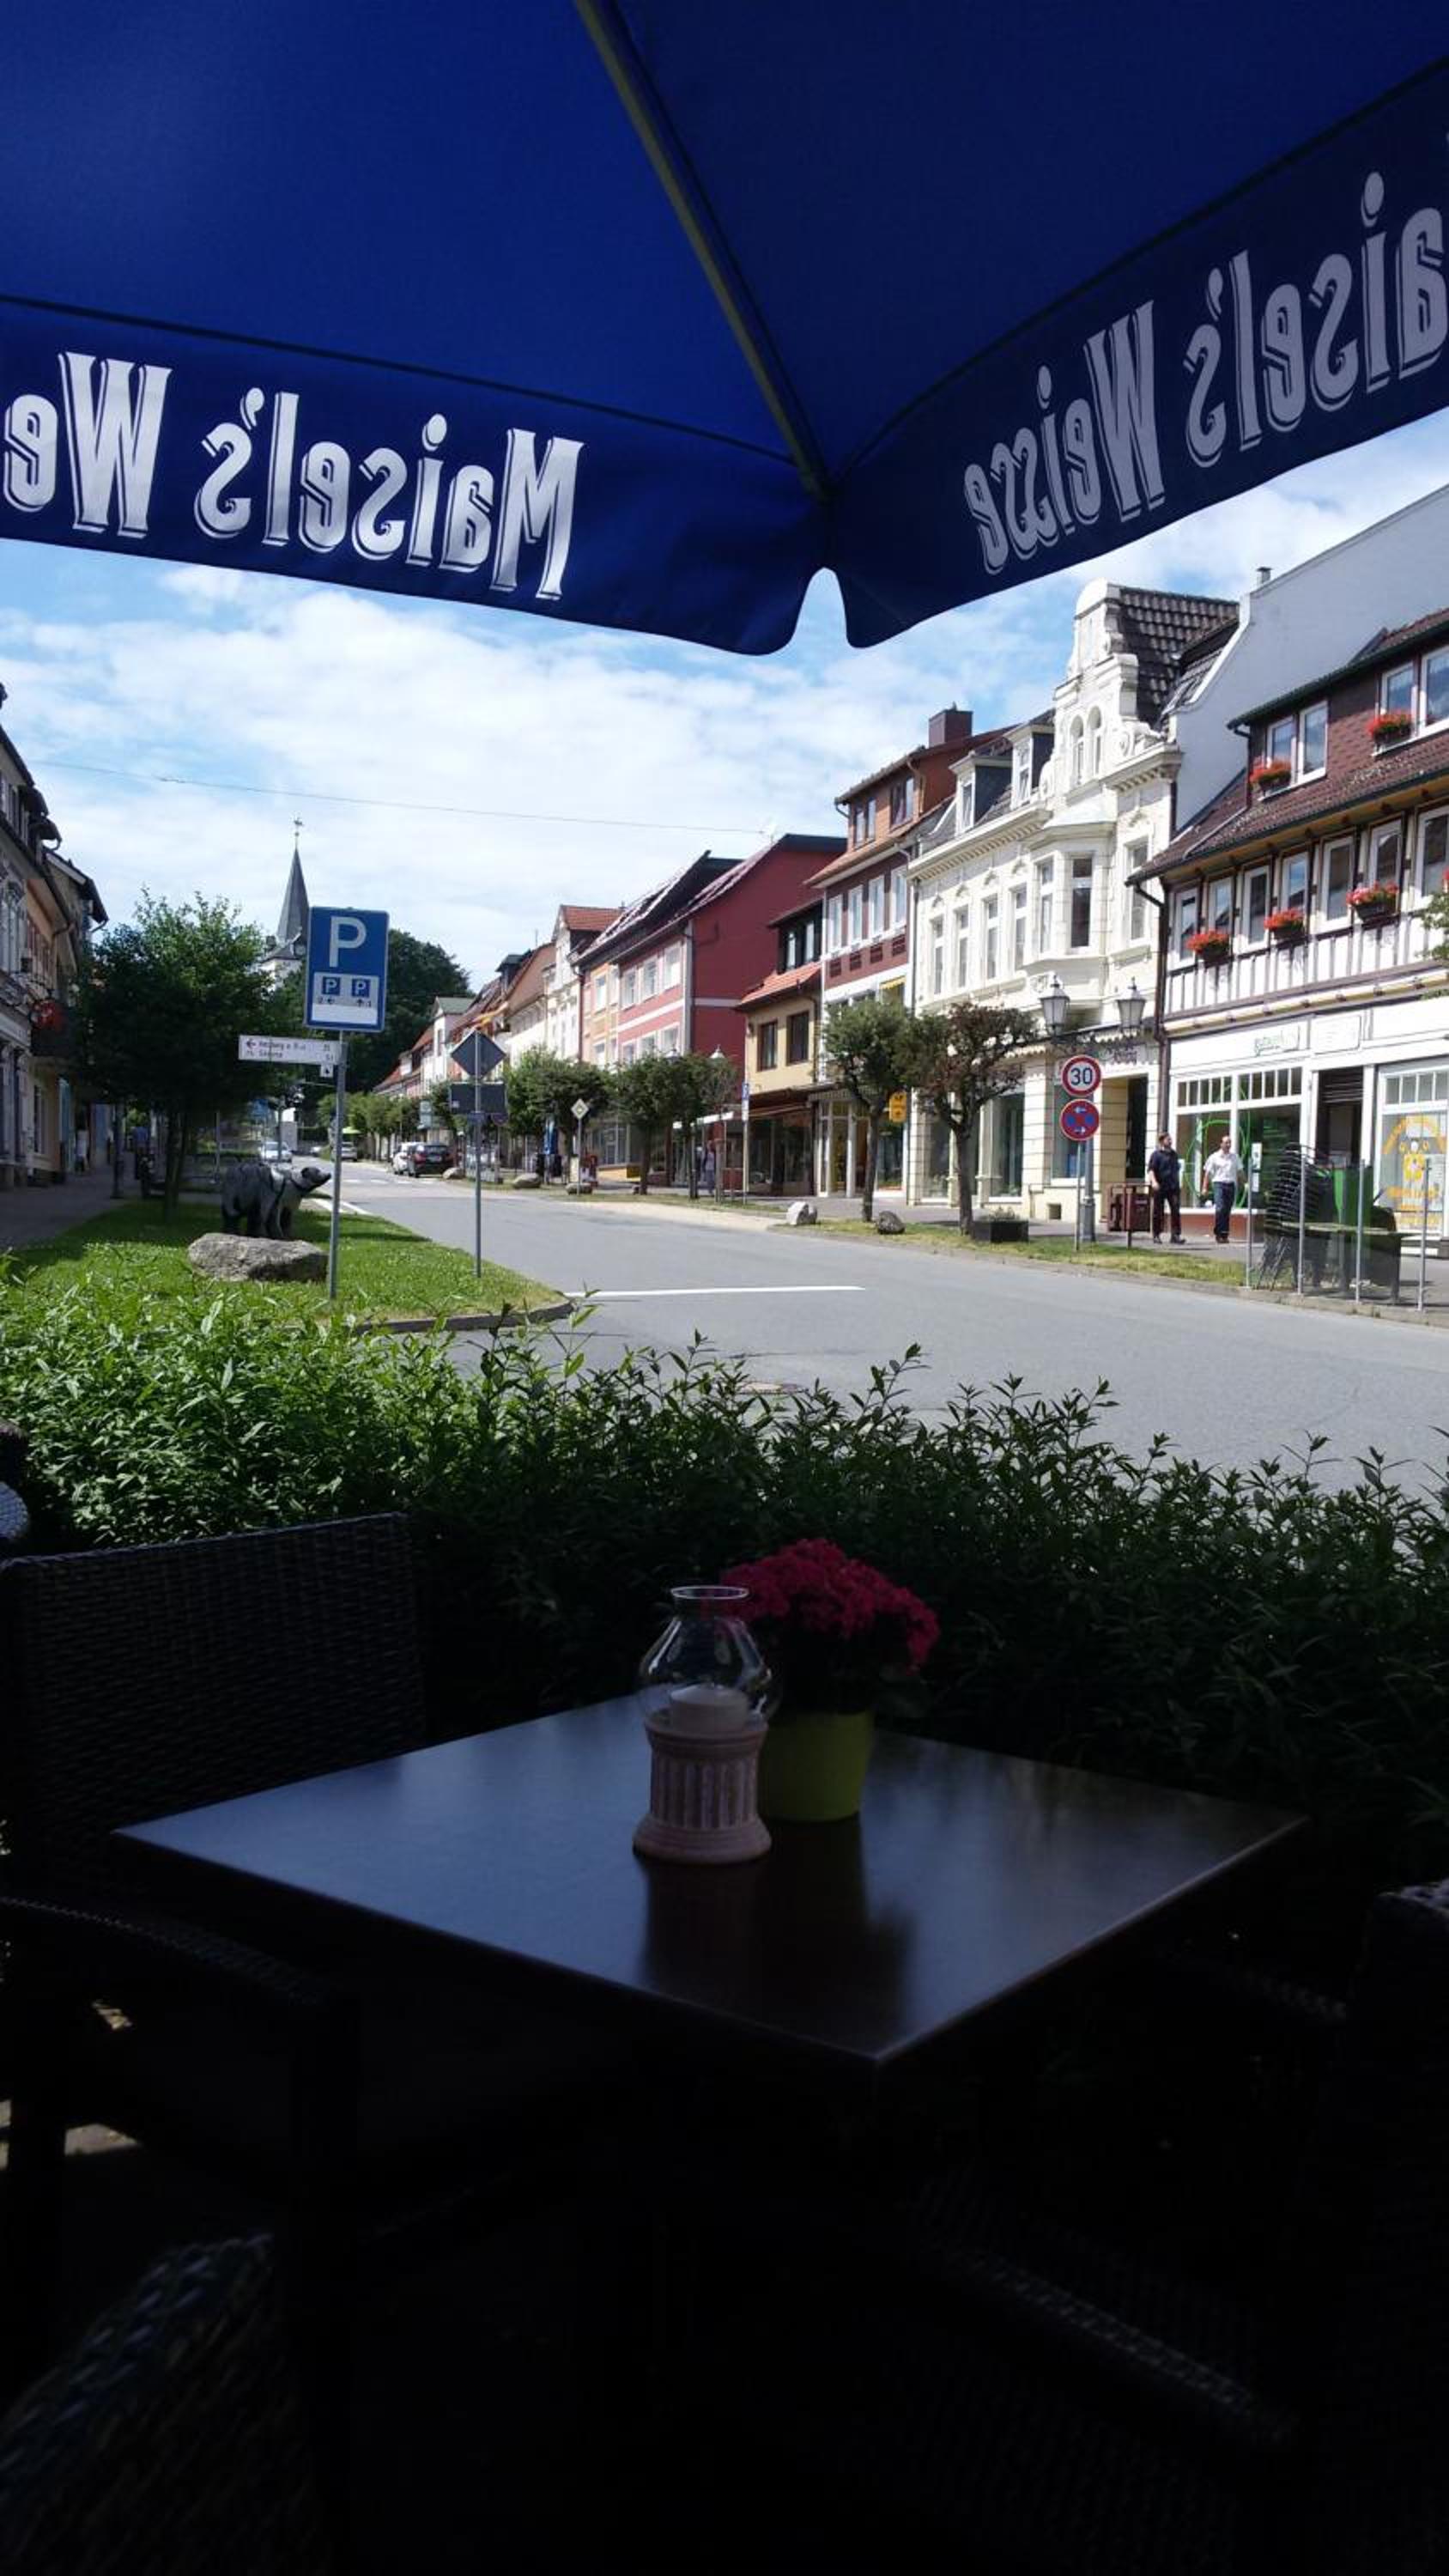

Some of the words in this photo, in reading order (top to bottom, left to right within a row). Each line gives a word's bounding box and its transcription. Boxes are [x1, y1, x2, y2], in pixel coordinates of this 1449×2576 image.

[329, 915, 367, 968] P
[325, 978, 337, 993] P
[355, 980, 367, 994] P
[1070, 1067, 1094, 1086] 30
